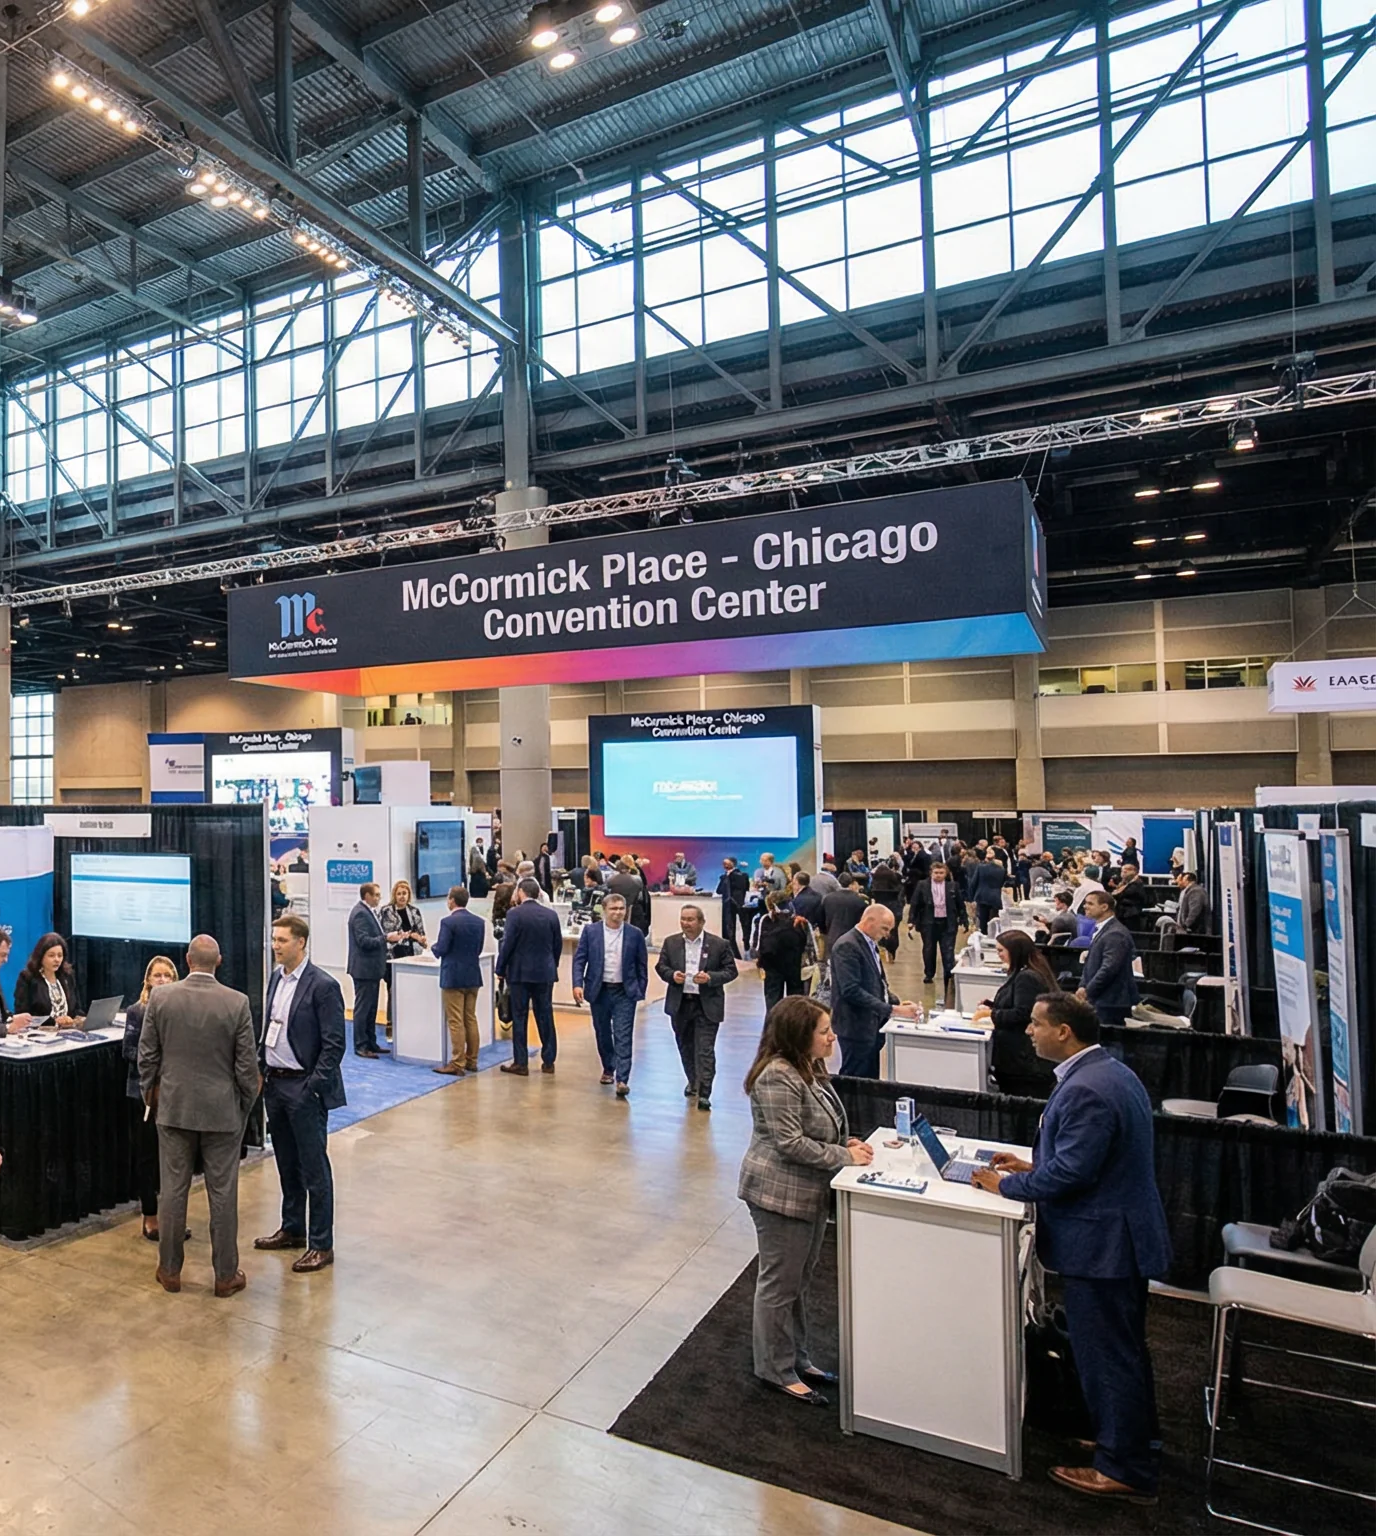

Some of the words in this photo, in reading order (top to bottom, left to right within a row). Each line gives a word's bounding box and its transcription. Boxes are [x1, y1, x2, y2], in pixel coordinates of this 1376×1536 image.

[402, 559, 591, 612] McCormick
[602, 550, 707, 588] Place
[753, 521, 939, 571] Chicago
[483, 594, 678, 641] Convention
[691, 579, 827, 622] Center
